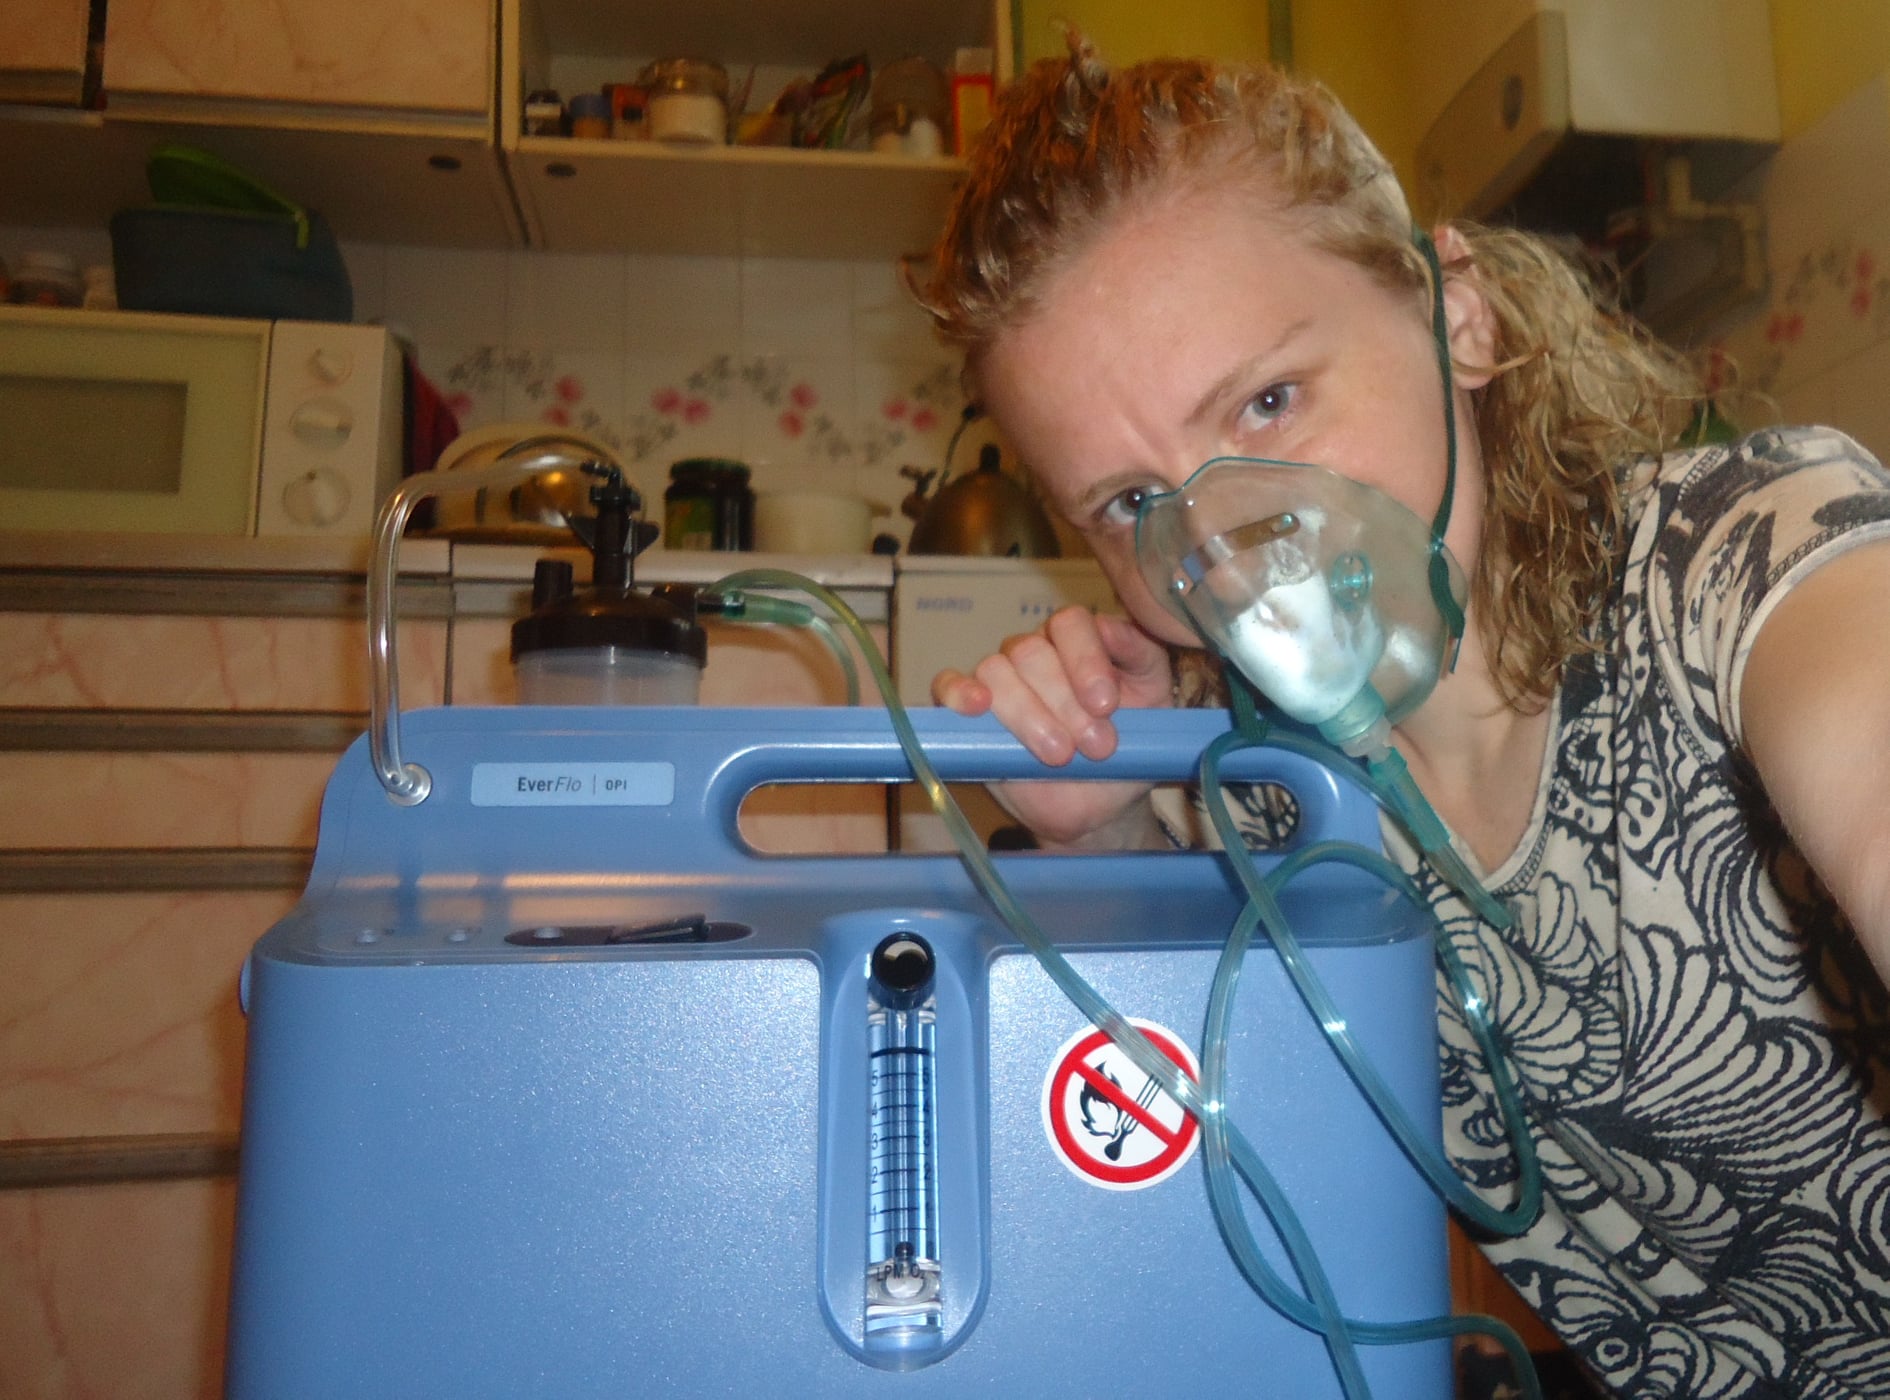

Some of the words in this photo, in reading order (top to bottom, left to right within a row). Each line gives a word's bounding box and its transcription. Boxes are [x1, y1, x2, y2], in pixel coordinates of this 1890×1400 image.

[517, 776, 582, 792] EverFlo
[871, 1069, 878, 1087] 5
[923, 1066, 930, 1084] 5
[871, 1101, 878, 1118] 4
[923, 1097, 931, 1114] 4
[871, 1132, 878, 1150] 3
[871, 1165, 878, 1184] 2
[924, 1162, 931, 1180] 2
